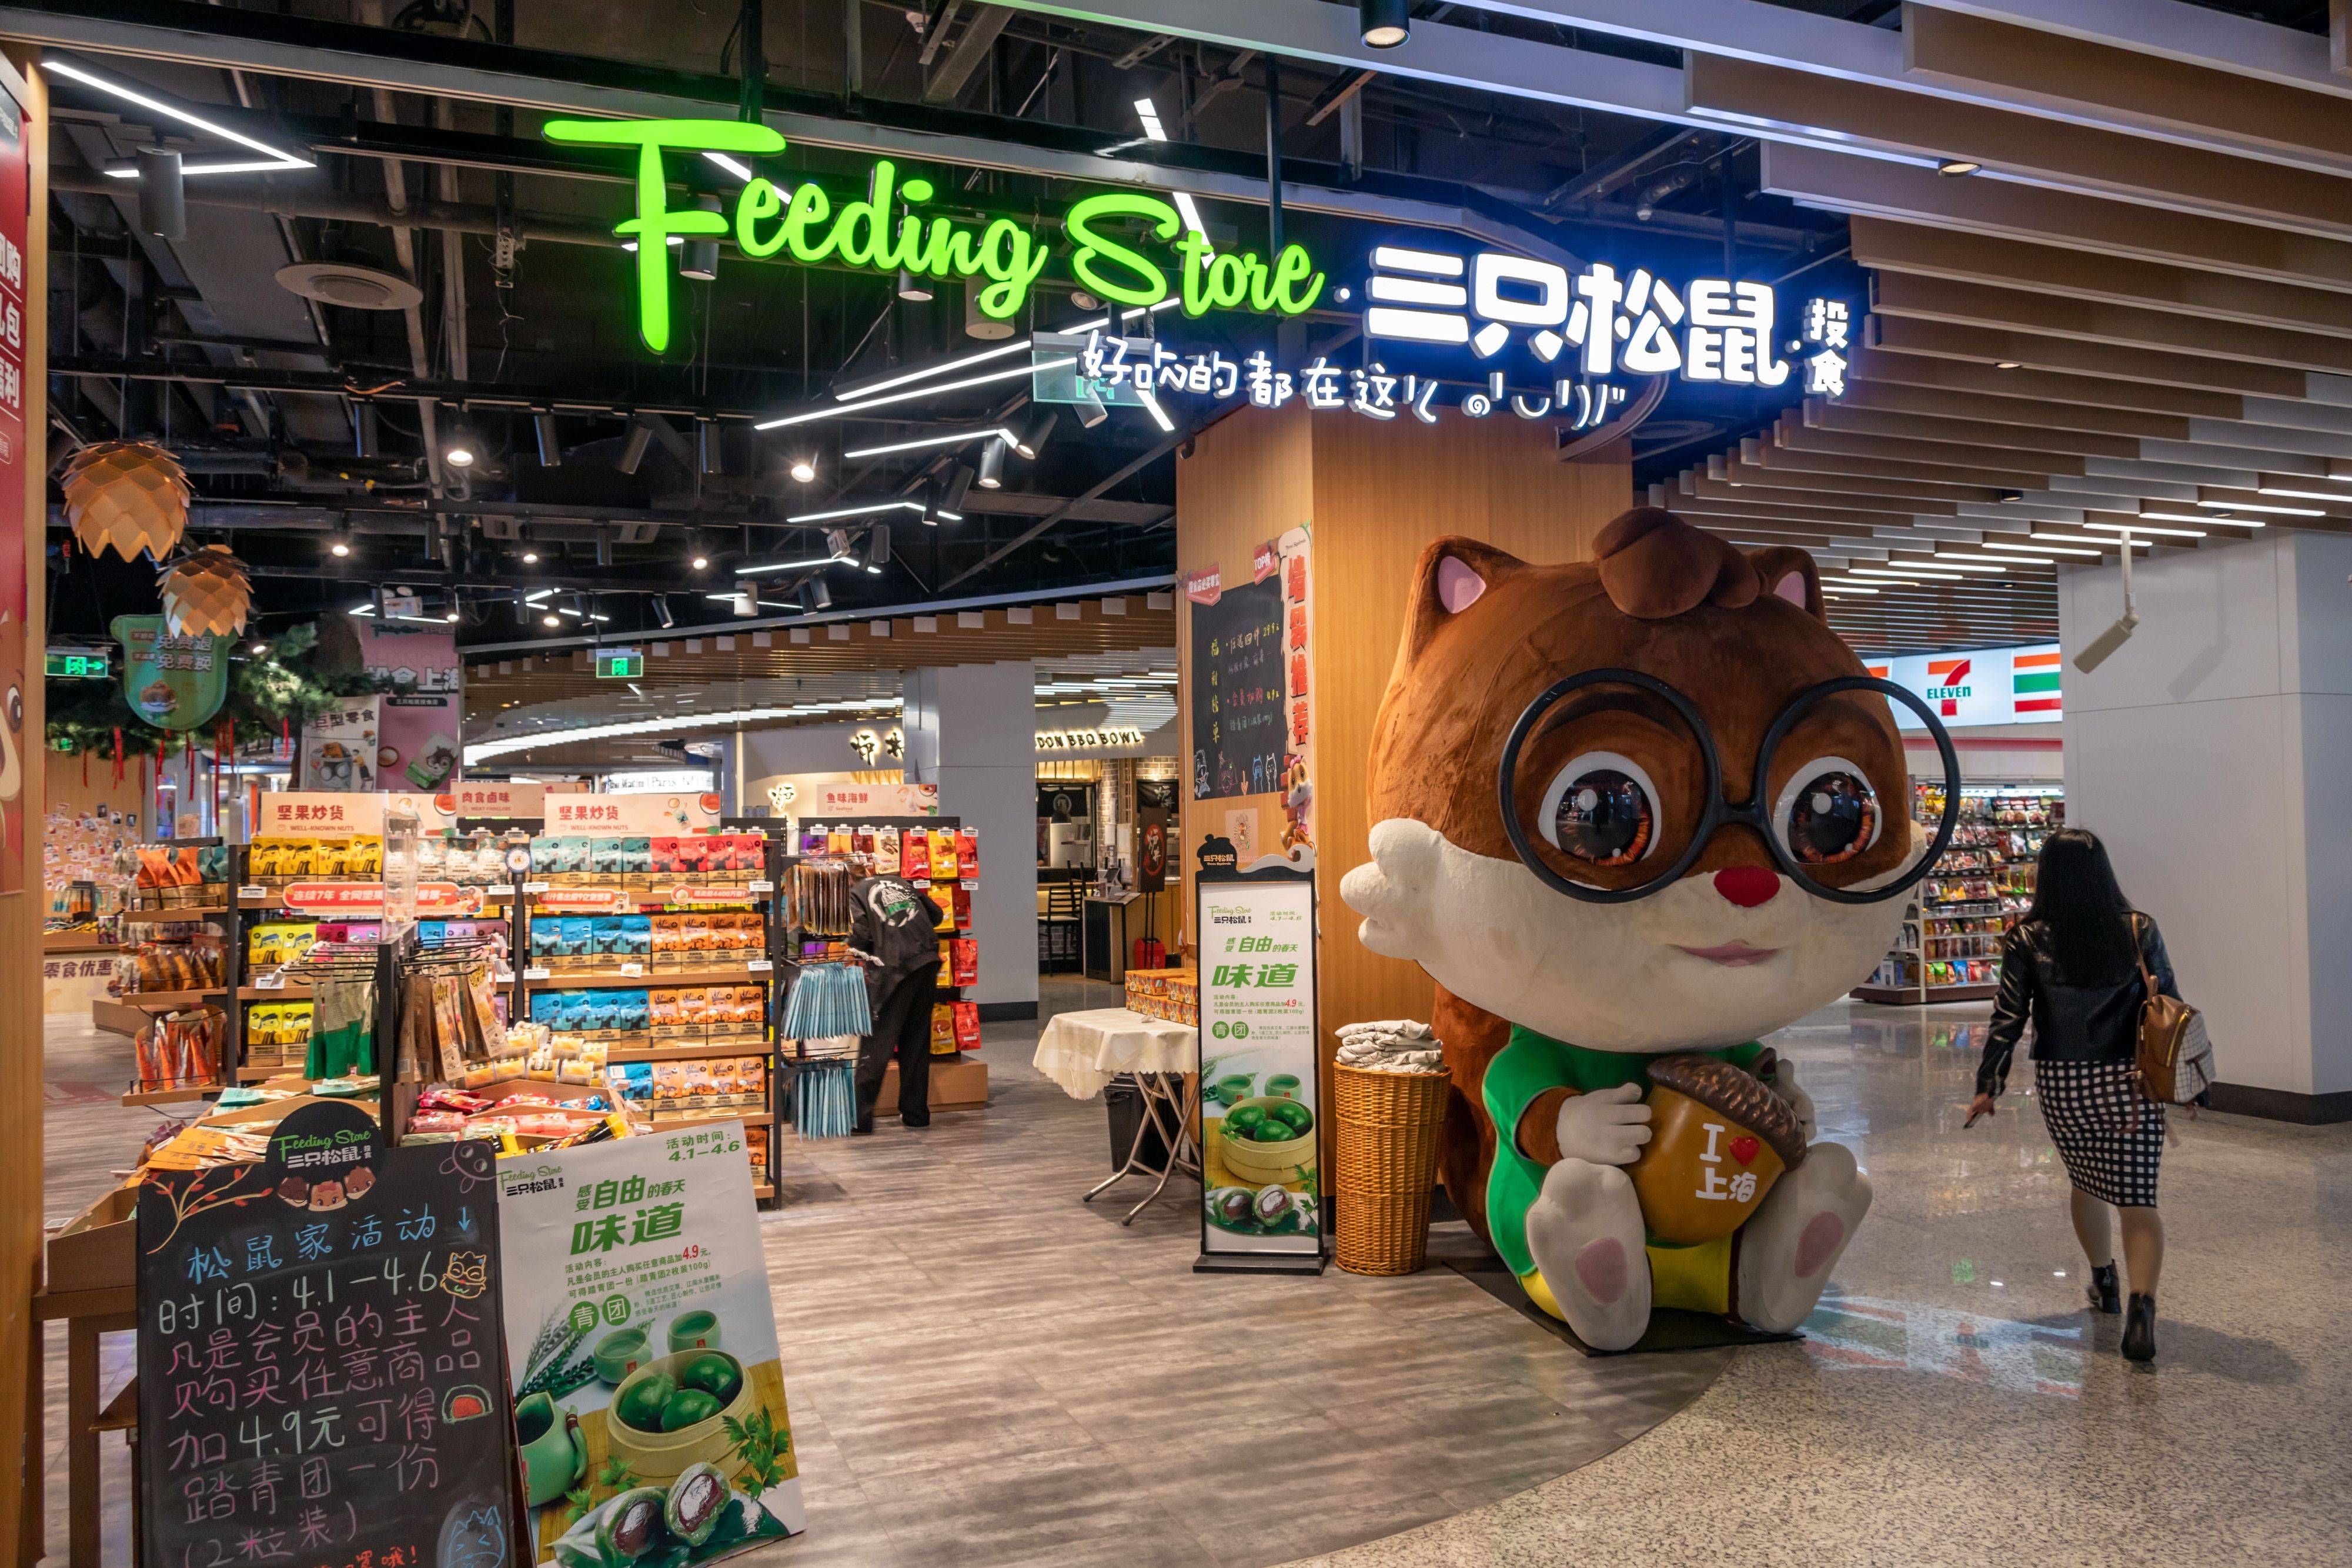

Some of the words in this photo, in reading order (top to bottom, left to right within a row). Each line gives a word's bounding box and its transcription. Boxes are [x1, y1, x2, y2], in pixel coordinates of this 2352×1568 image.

[541, 119, 1048, 352] Feeding
[1062, 193, 1325, 317] Store
[1364, 246, 1789, 388] 三只松鼠
[1805, 297, 1848, 396] 投食
[1927, 659, 1971, 717] 7
[1067, 733, 1097, 747] BBQ
[1099, 731, 1141, 745] BOWL
[462, 791, 510, 803] 肉食卤味
[827, 793, 868, 804] 鱼味海鲜
[278, 805, 343, 821] 坚果炒货
[559, 805, 619, 820] 坚果炒货
[1207, 905, 1234, 920] Feeding
[1235, 906, 1252, 914] Store
[1214, 915, 1247, 924] 三只松鼠
[1211, 964, 1299, 988] 味道
[272, 1134, 333, 1162] Feeding
[335, 1129, 371, 1144] Store
[1699, 1123, 1725, 1163] I
[287, 1146, 362, 1169] 三只松鼠
[496, 1169, 536, 1191] Feeding
[537, 1165, 563, 1176] Store
[506, 1178, 557, 1196] 三只松鼠
[570, 1202, 685, 1256] 味道
[187, 1202, 436, 1285] 松鼠家活动
[573, 1298, 627, 1329] 青团
[166, 1293, 480, 1375] 凡是会员的主人
[184, 1444, 439, 1524] 踏青团一份
